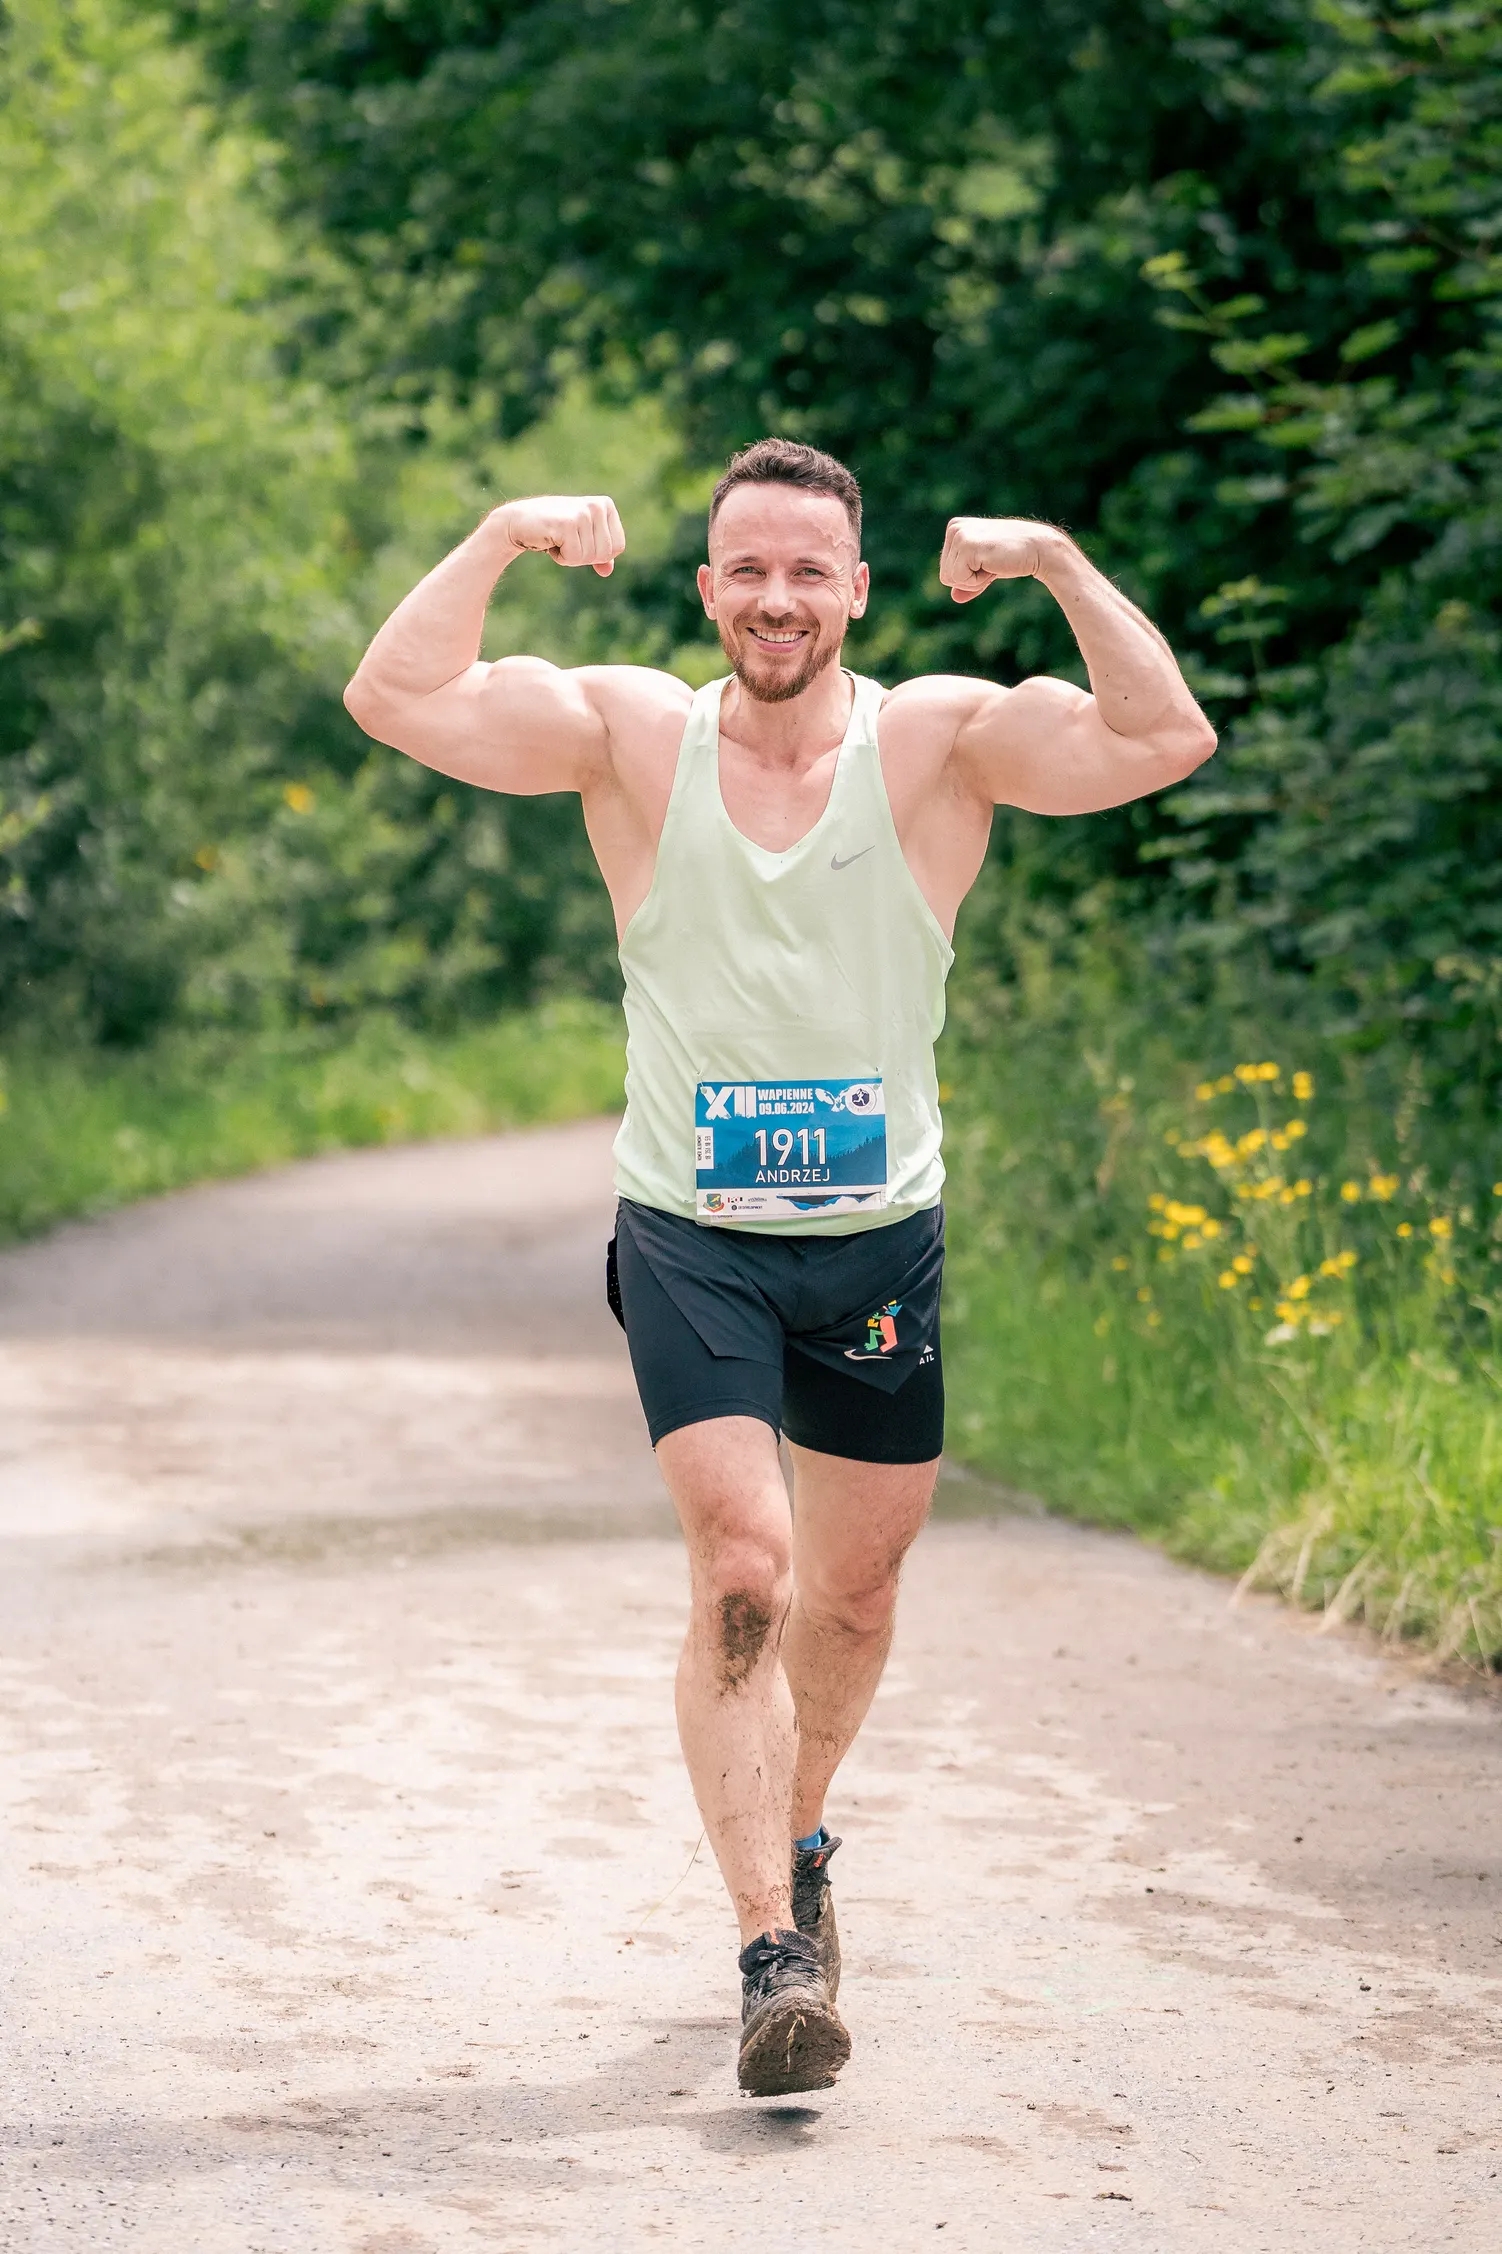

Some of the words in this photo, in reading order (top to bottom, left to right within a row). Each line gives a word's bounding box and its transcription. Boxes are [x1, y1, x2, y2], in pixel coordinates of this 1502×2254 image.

[757, 1087, 814, 1101] WAPIENNE
[702, 1085, 757, 1120] XII
[758, 1102, 815, 1115] 09.06.2024
[754, 1127, 827, 1166] 1911
[755, 1168, 831, 1183] ANDRZEJ
[919, 1354, 935, 1366] AIL
